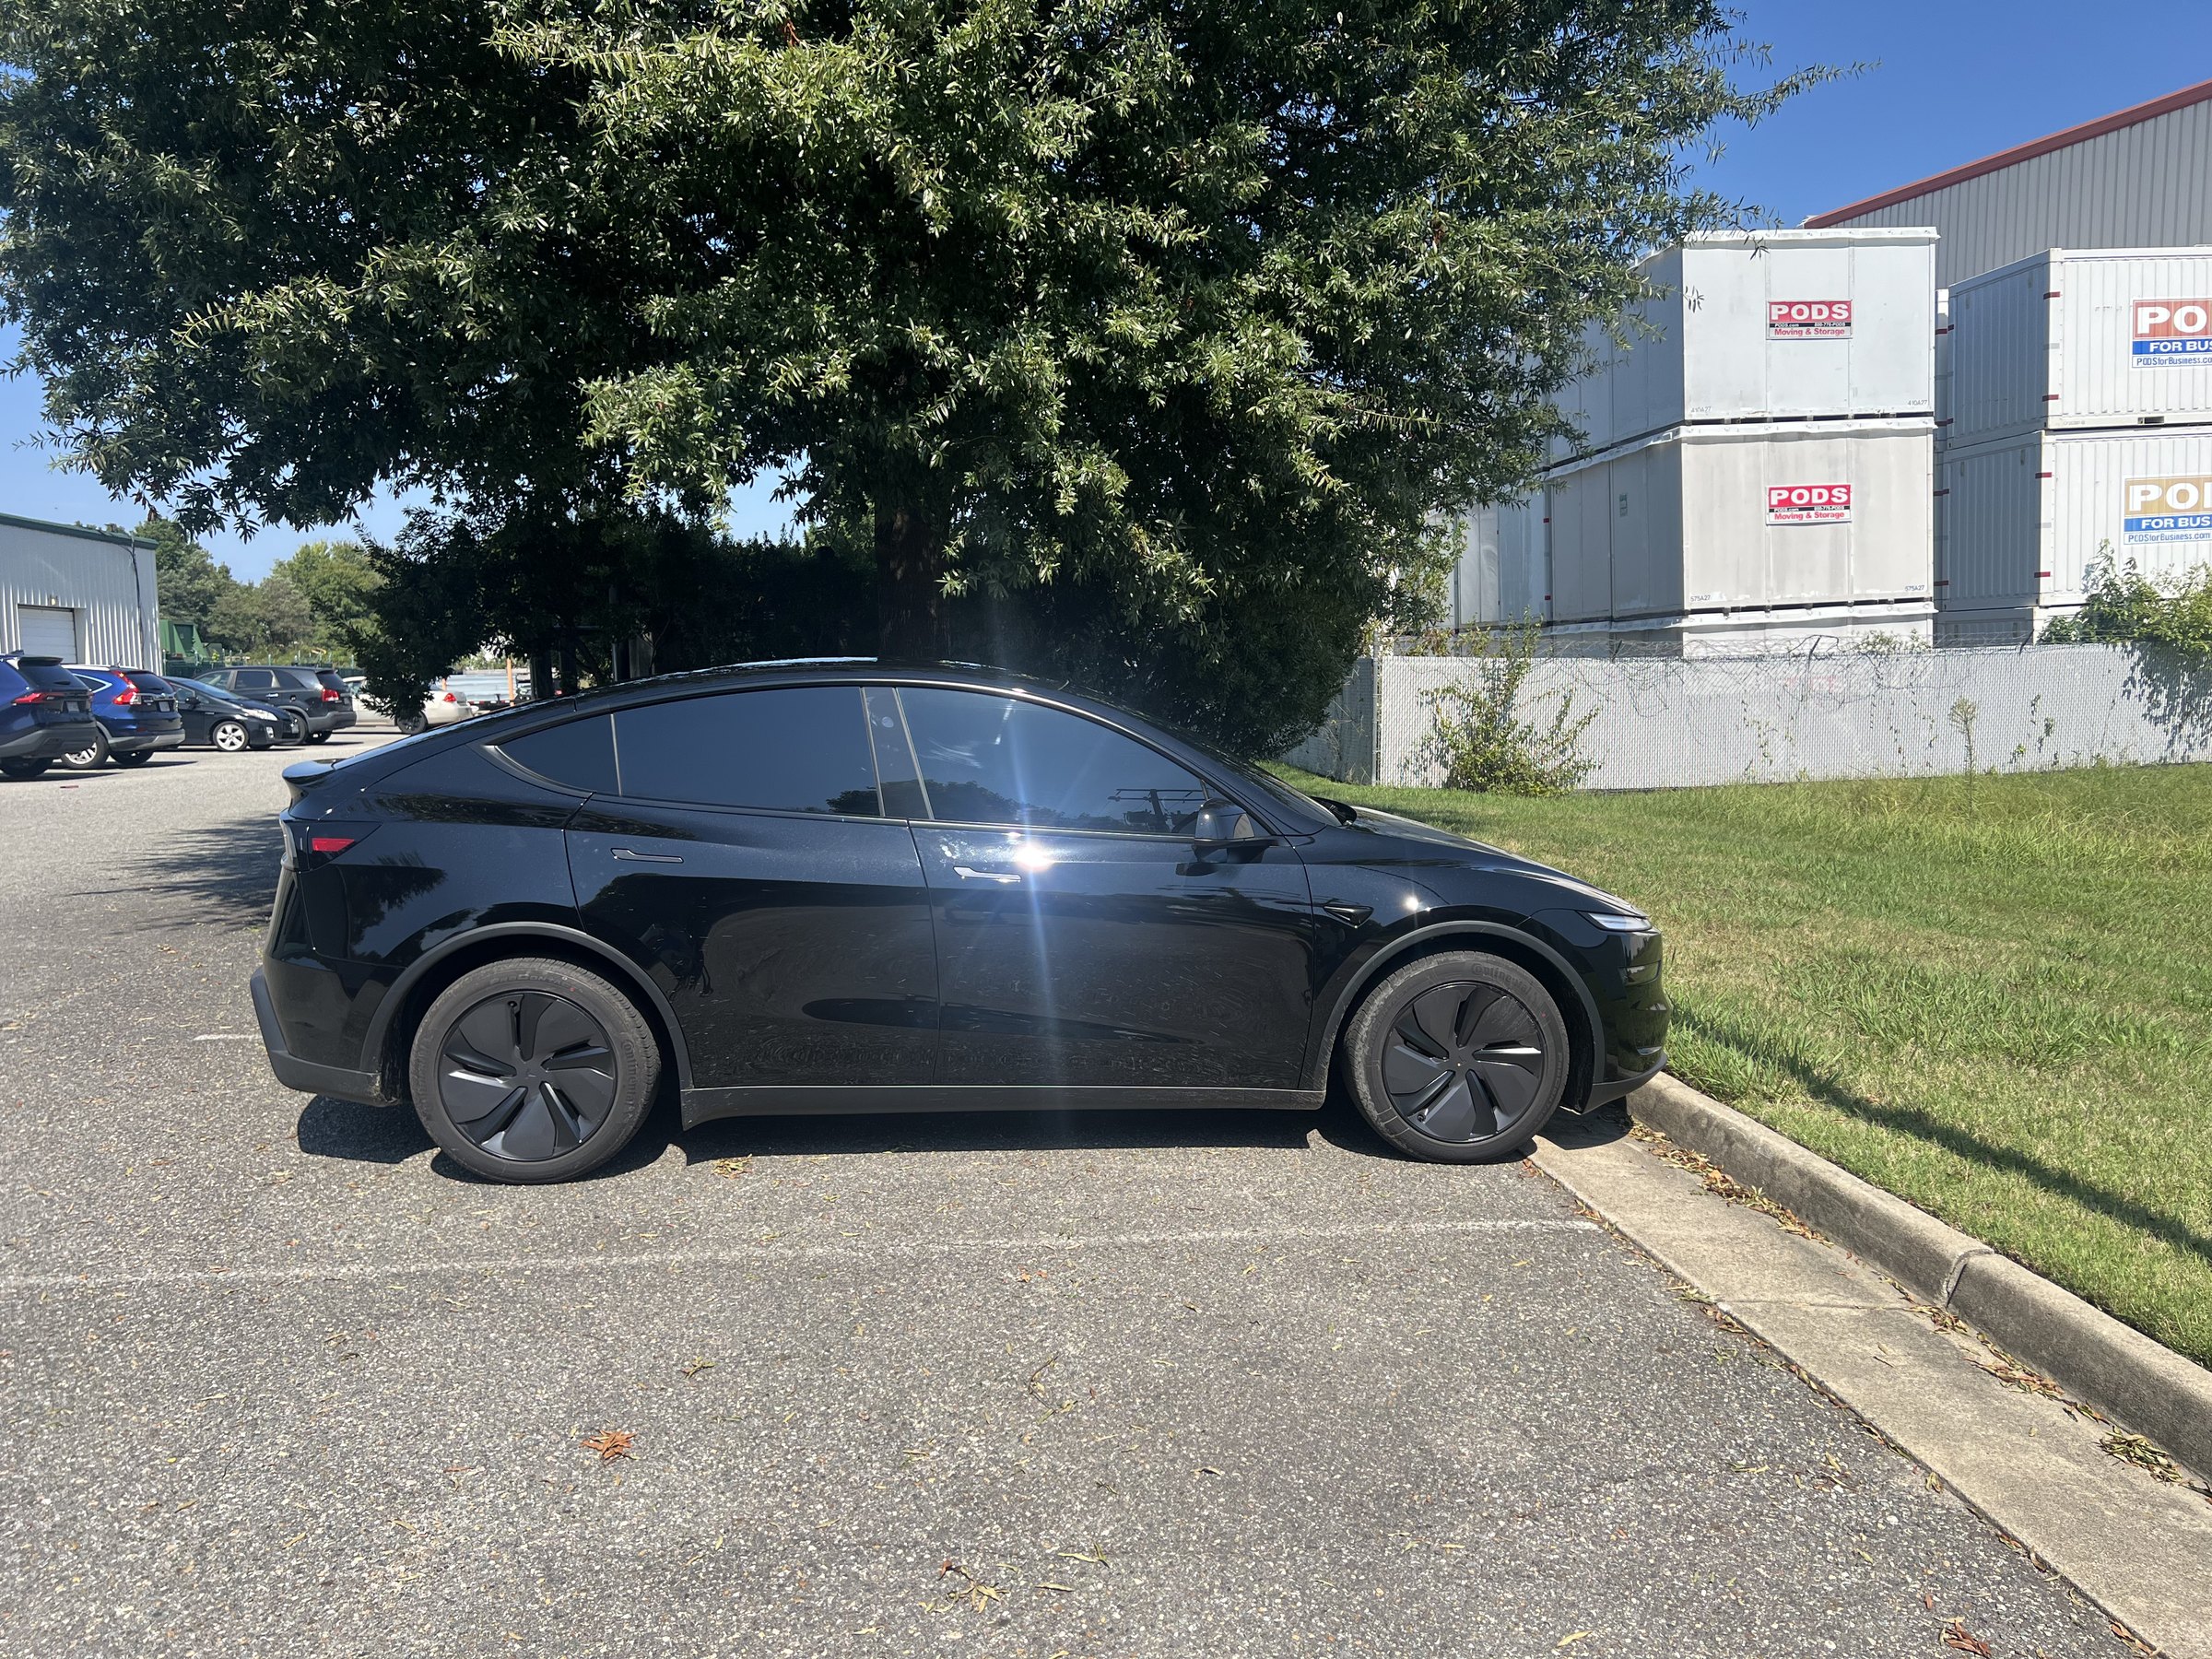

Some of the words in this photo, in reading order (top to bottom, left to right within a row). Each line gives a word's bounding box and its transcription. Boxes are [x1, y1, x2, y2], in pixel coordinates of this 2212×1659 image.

[1771, 303, 1849, 320] PODS
[1774, 328, 1803, 336] Moving
[1814, 328, 1845, 336] Storage
[2149, 341, 2183, 352] FOR
[1770, 488, 1848, 506] PODS
[2129, 482, 2212, 512] PO
[1774, 512, 1804, 521] Moving
[1814, 512, 1845, 520] Storage
[2141, 518, 2174, 529] FOR
[2178, 516, 2211, 527] BUS
[2128, 533, 2211, 543] PODSforBusiness.com
[620, 1039, 637, 1105] Continental
